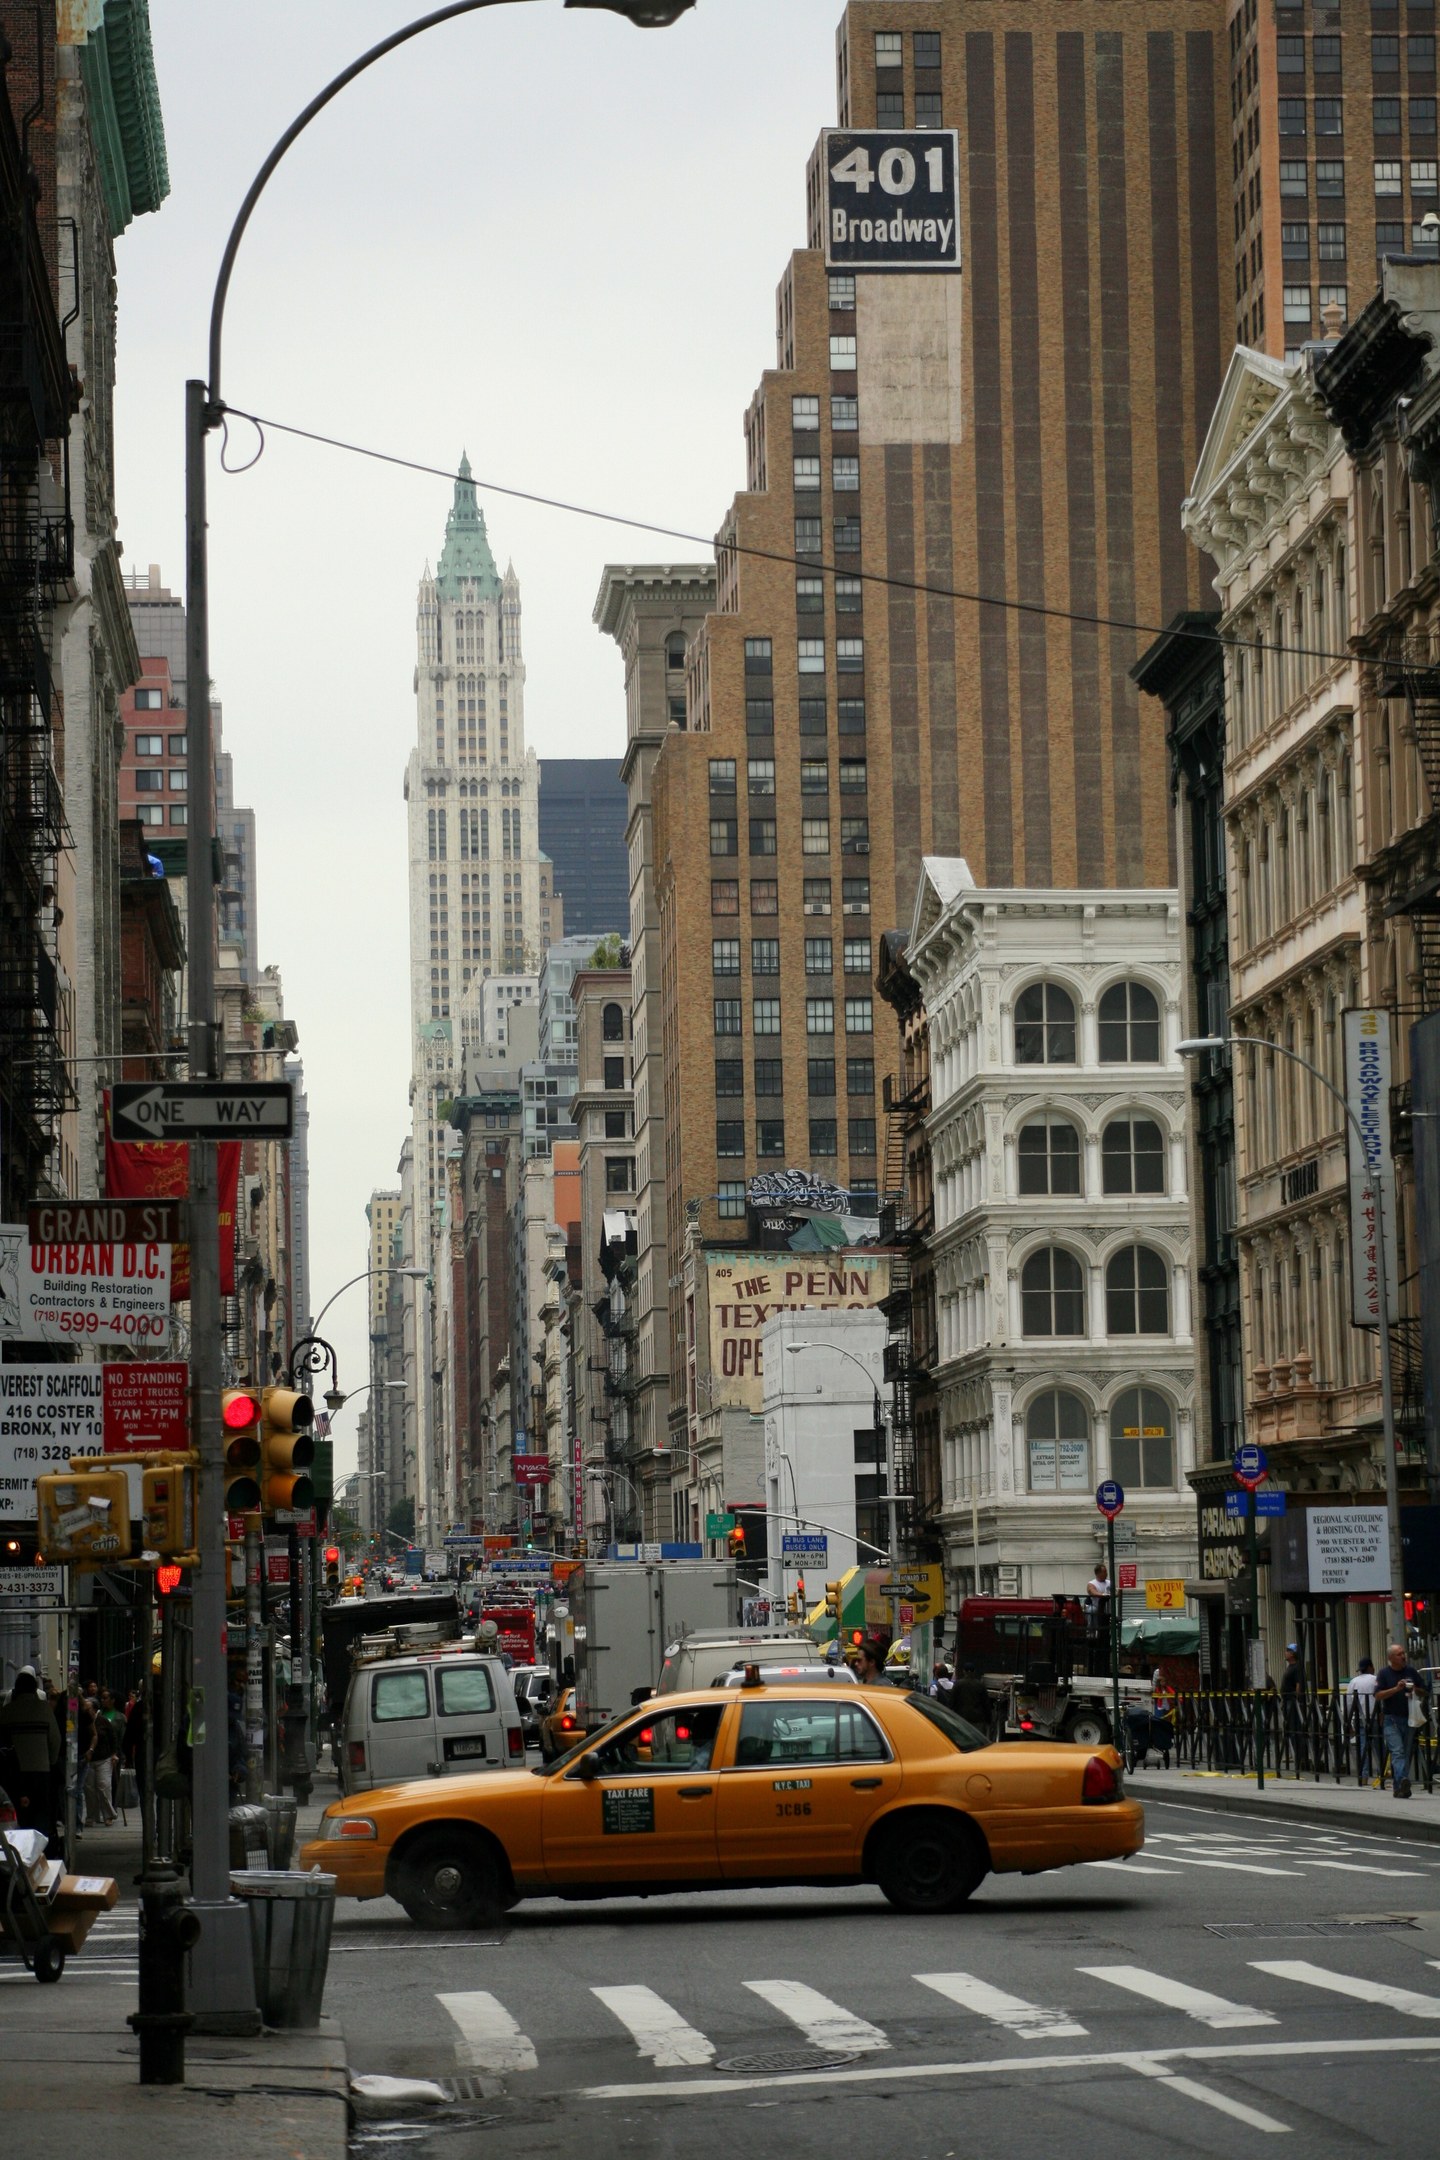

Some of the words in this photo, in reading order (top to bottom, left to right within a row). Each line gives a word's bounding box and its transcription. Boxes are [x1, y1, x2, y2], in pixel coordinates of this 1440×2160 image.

[830, 146, 943, 195] 401
[832, 208, 953, 253] Broadway
[136, 1101, 185, 1123] ONE
[216, 1101, 266, 1122] WAY
[39, 1208, 126, 1242] GRAND
[142, 1207, 171, 1241] ST
[30, 1243, 114, 1277] URBAN
[122, 1242, 166, 1280] D.C.
[715, 1269, 733, 1278] 405
[43, 1279, 87, 1294] Building
[91, 1281, 153, 1295] Restoration
[732, 1275, 771, 1300] THE
[785, 1271, 869, 1296] PENN
[30, 1294, 95, 1308] Contractors
[99, 1296, 107, 1308] &
[112, 1299, 166, 1312] Engineers
[108, 1373, 124, 1385] NO
[129, 1372, 183, 1385] STANDING
[112, 1388, 143, 1398] EXCEPT
[147, 1387, 180, 1397] TRUCKS
[6, 1405, 33, 1418] 416
[36, 1404, 95, 1419] COSTER
[1, 1422, 56, 1438] BRONX,
[60, 1422, 82, 1436] NY
[14, 1447, 39, 1462] (718)
[1226, 1494, 1238, 1504] M1
[1227, 1508, 1239, 1516] M6
[1312, 1514, 1342, 1524] REGIONAL
[1344, 1514, 1384, 1523] SCAFFOLDING
[1322, 1526, 1352, 1534] HOISTING
[1321, 1546, 1347, 1554] BRONX,
[1203, 1545, 1240, 1579] FABRICS
[1148, 1584, 1161, 1592] ANY
[1164, 1582, 1180, 1592] ITEM
[795, 1780, 811, 1789] TAXI
[607, 1790, 626, 1799] TAXI
[628, 1788, 649, 1798] FARE
